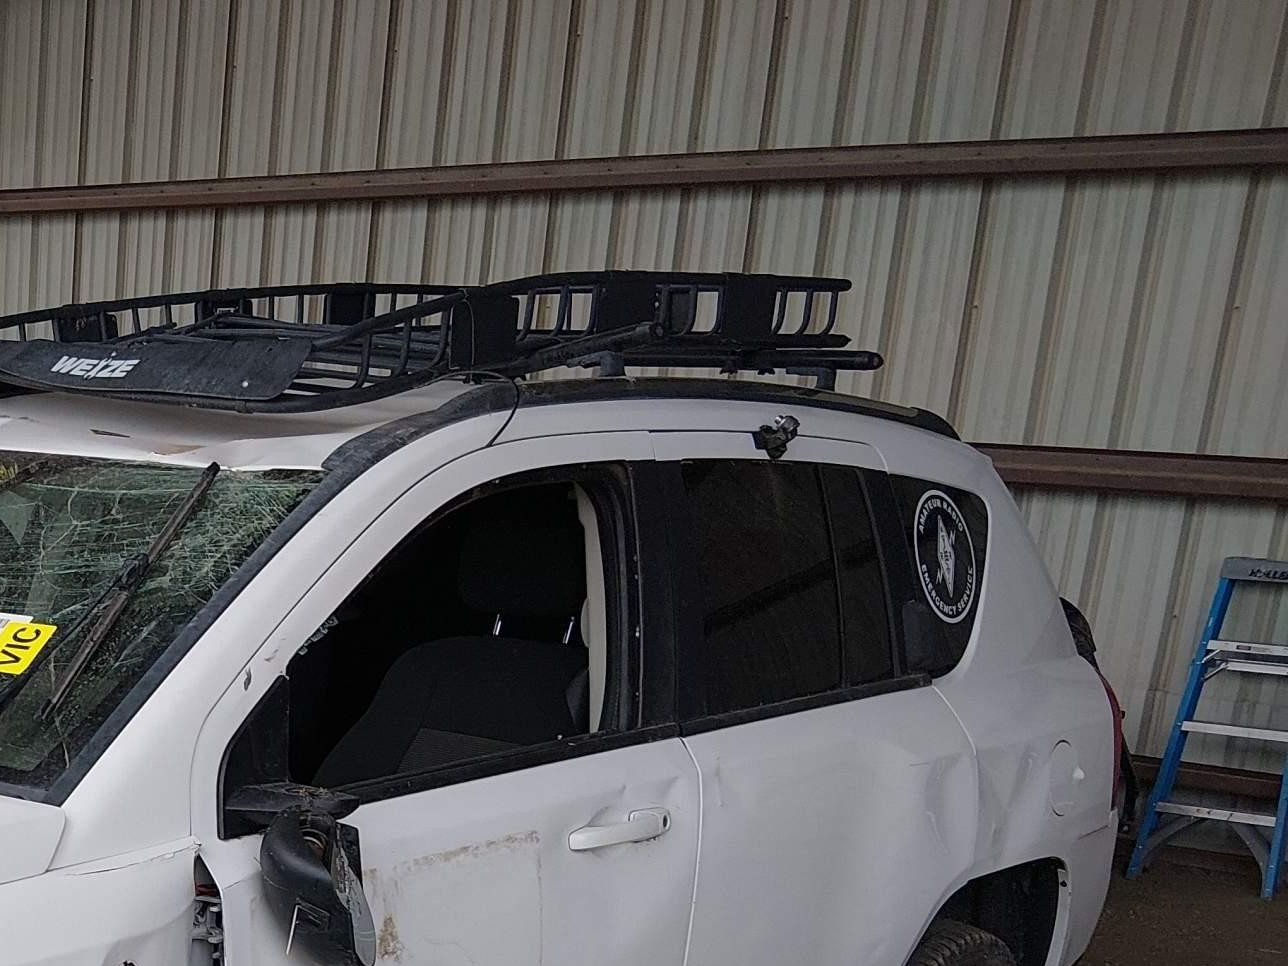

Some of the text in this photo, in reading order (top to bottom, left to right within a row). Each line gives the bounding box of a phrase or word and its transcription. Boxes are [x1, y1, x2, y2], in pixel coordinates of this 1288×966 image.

[51, 351, 141, 379] WEIZE
[918, 498, 964, 535] AMATEUR RADIO
[921, 563, 973, 615] EMERGENCY SERVICE
